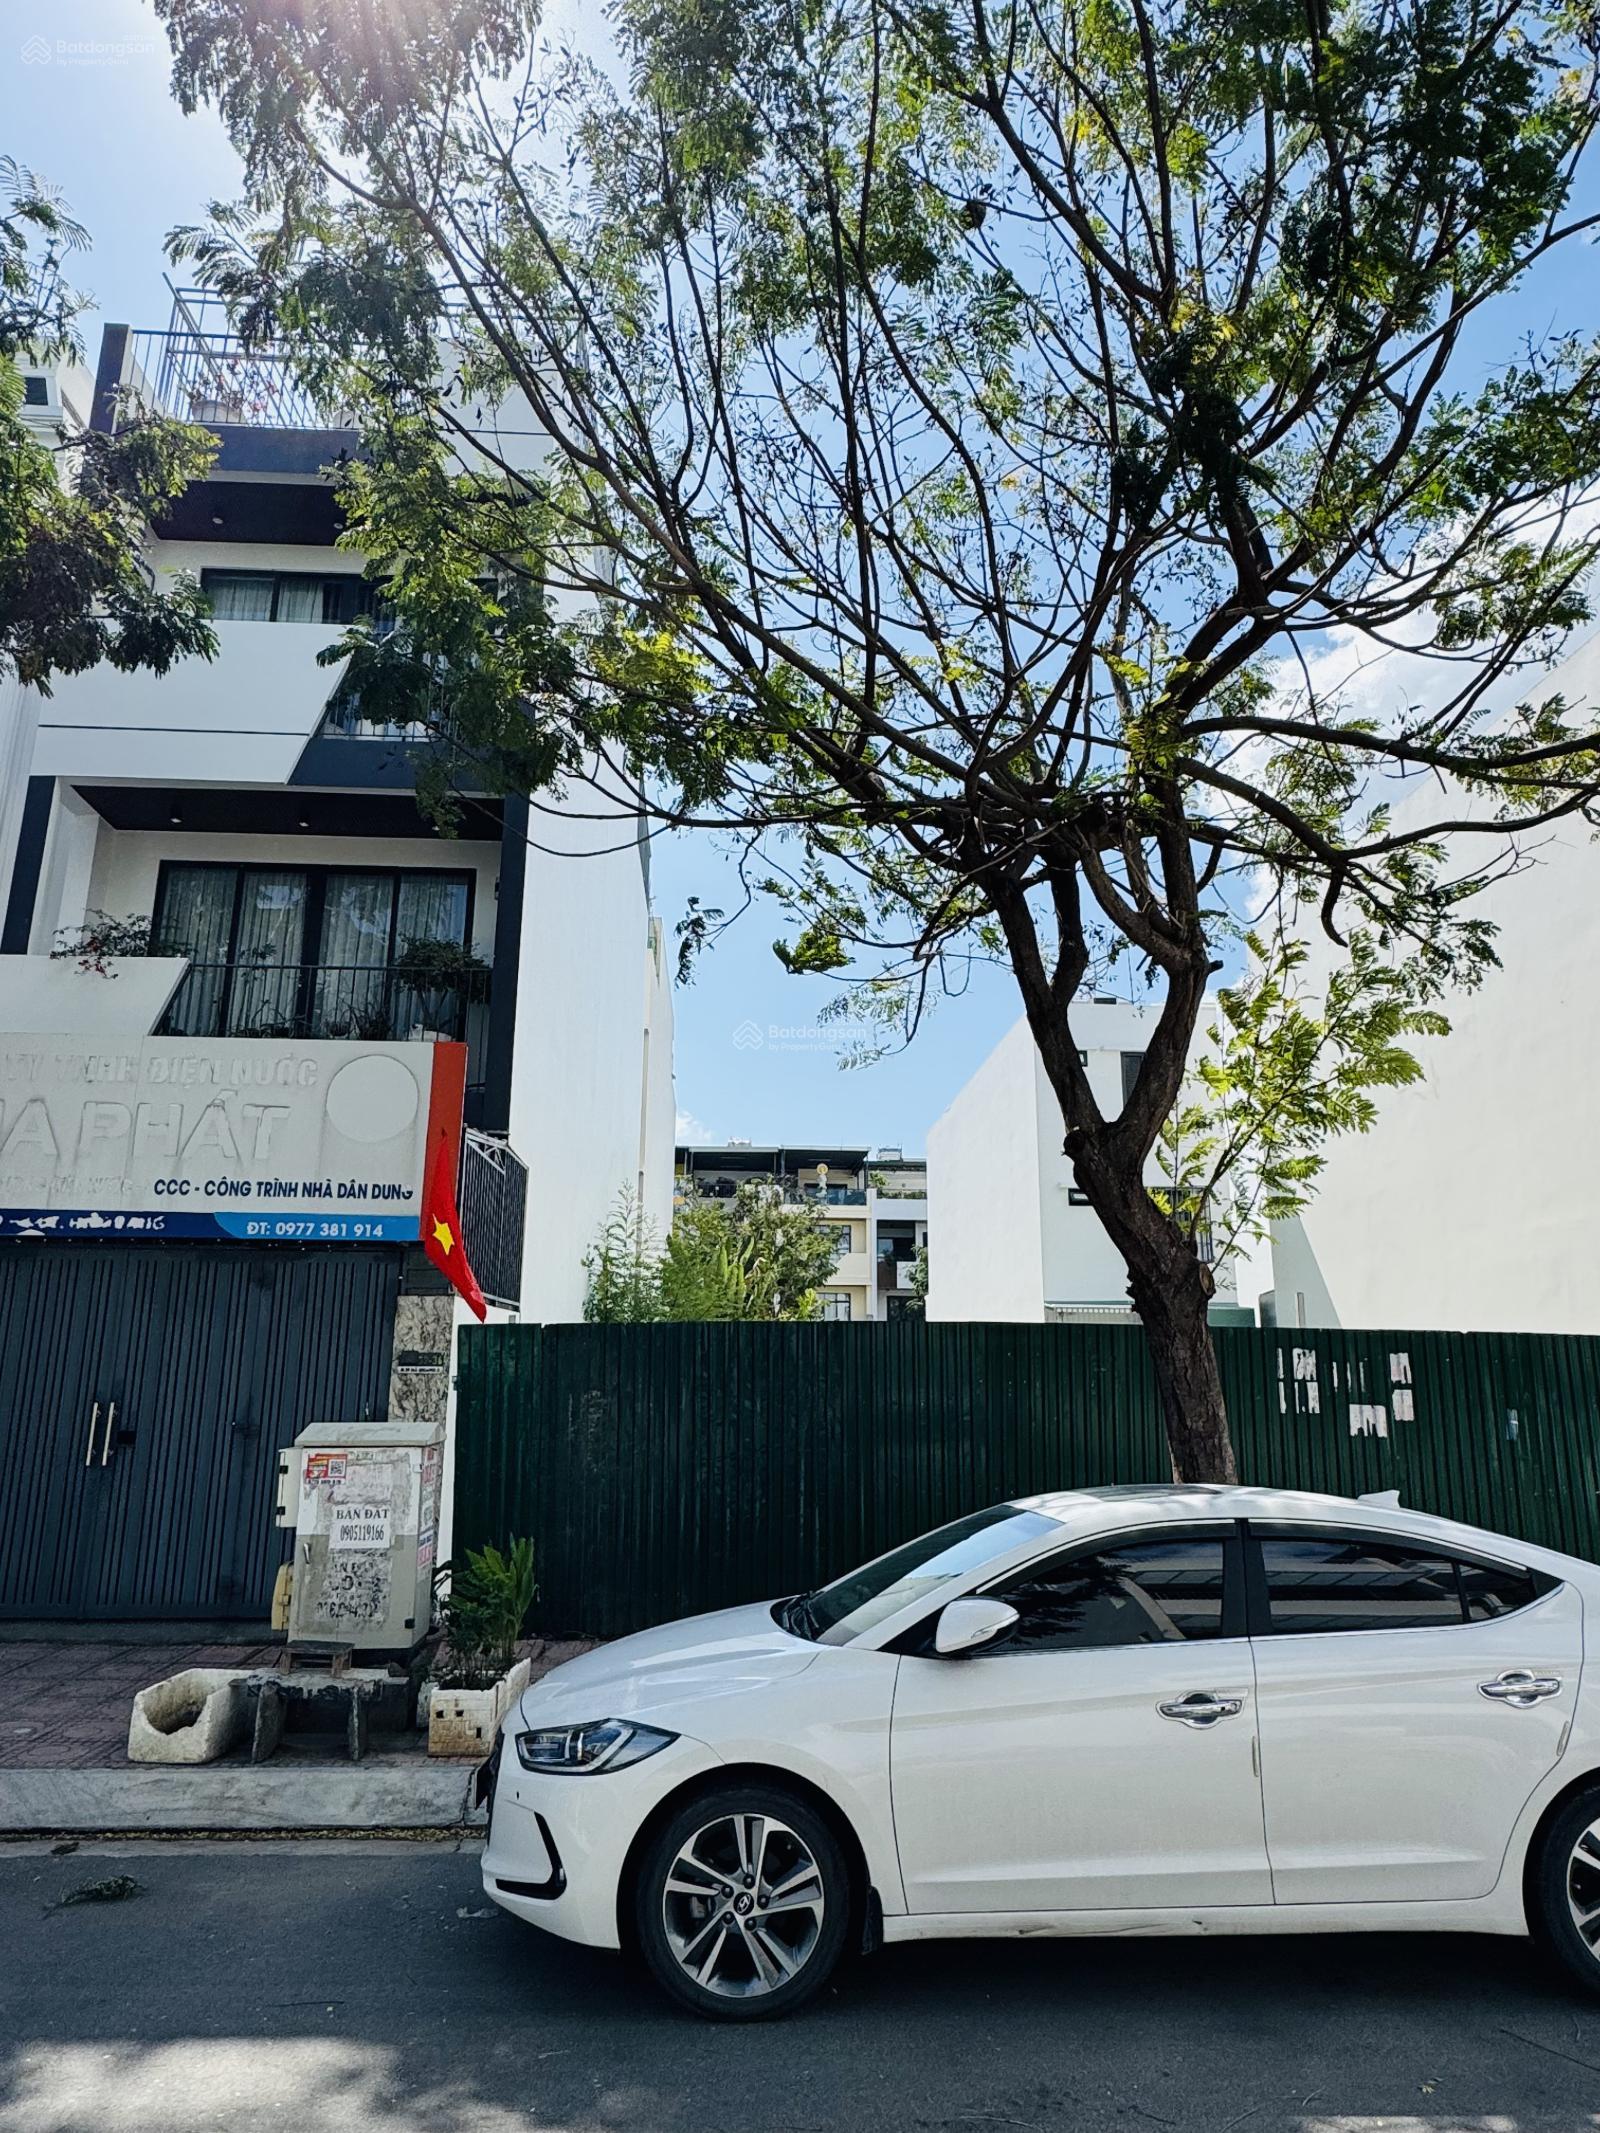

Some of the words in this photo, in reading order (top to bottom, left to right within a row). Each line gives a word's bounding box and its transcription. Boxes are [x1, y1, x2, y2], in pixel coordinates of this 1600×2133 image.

[204, 1175, 251, 1197] CÔNG
[256, 1178, 299, 1198] TRÌNH
[302, 1178, 334, 1199] NHÀ
[337, 1178, 368, 1200] DÂN
[246, 1221, 271, 1235] ĐT:
[275, 1221, 315, 1236] 0977
[319, 1223, 347, 1237] 381
[353, 1223, 383, 1238] 914
[340, 1524, 385, 1541] 0905119166
